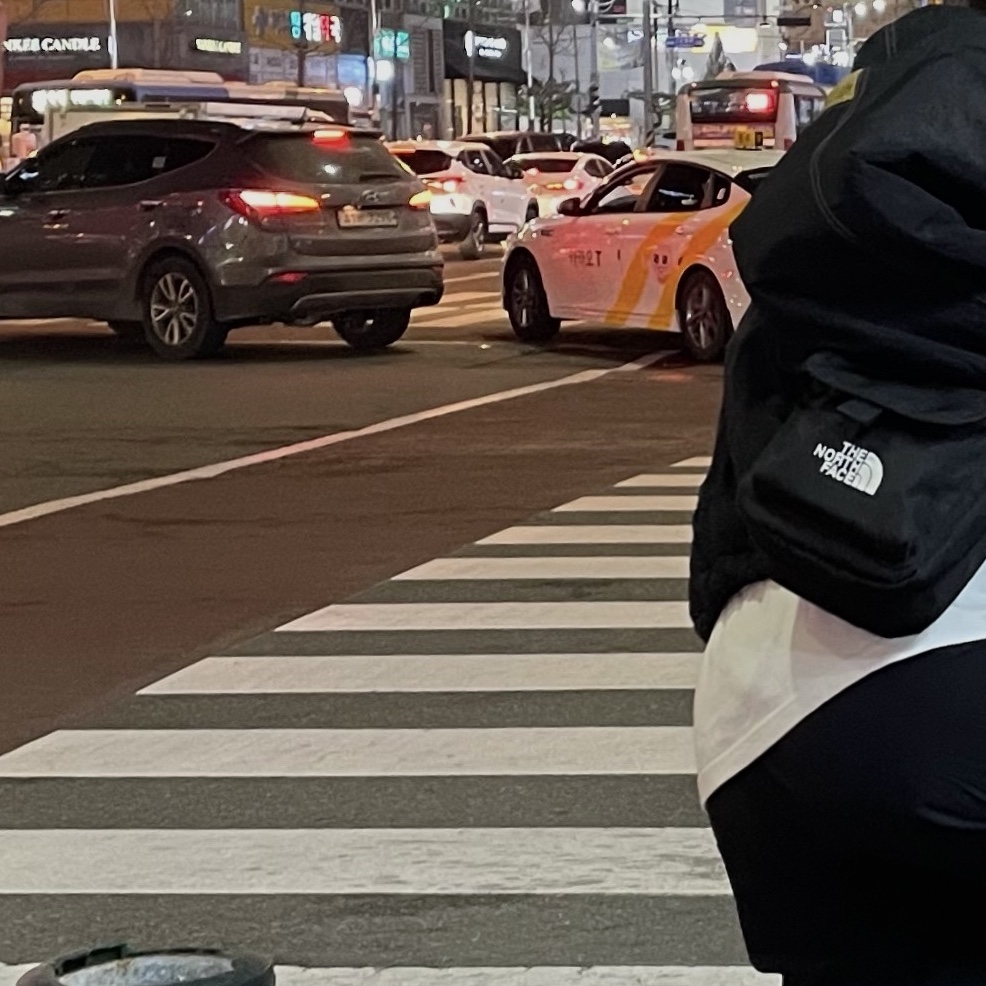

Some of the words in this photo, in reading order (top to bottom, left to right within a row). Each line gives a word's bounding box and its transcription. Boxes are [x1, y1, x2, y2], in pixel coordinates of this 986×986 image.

[41, 37, 100, 51] CANDLE
[813, 443, 861, 474] NORTH
[841, 441, 868, 461] THE
[820, 461, 857, 485] FACE
